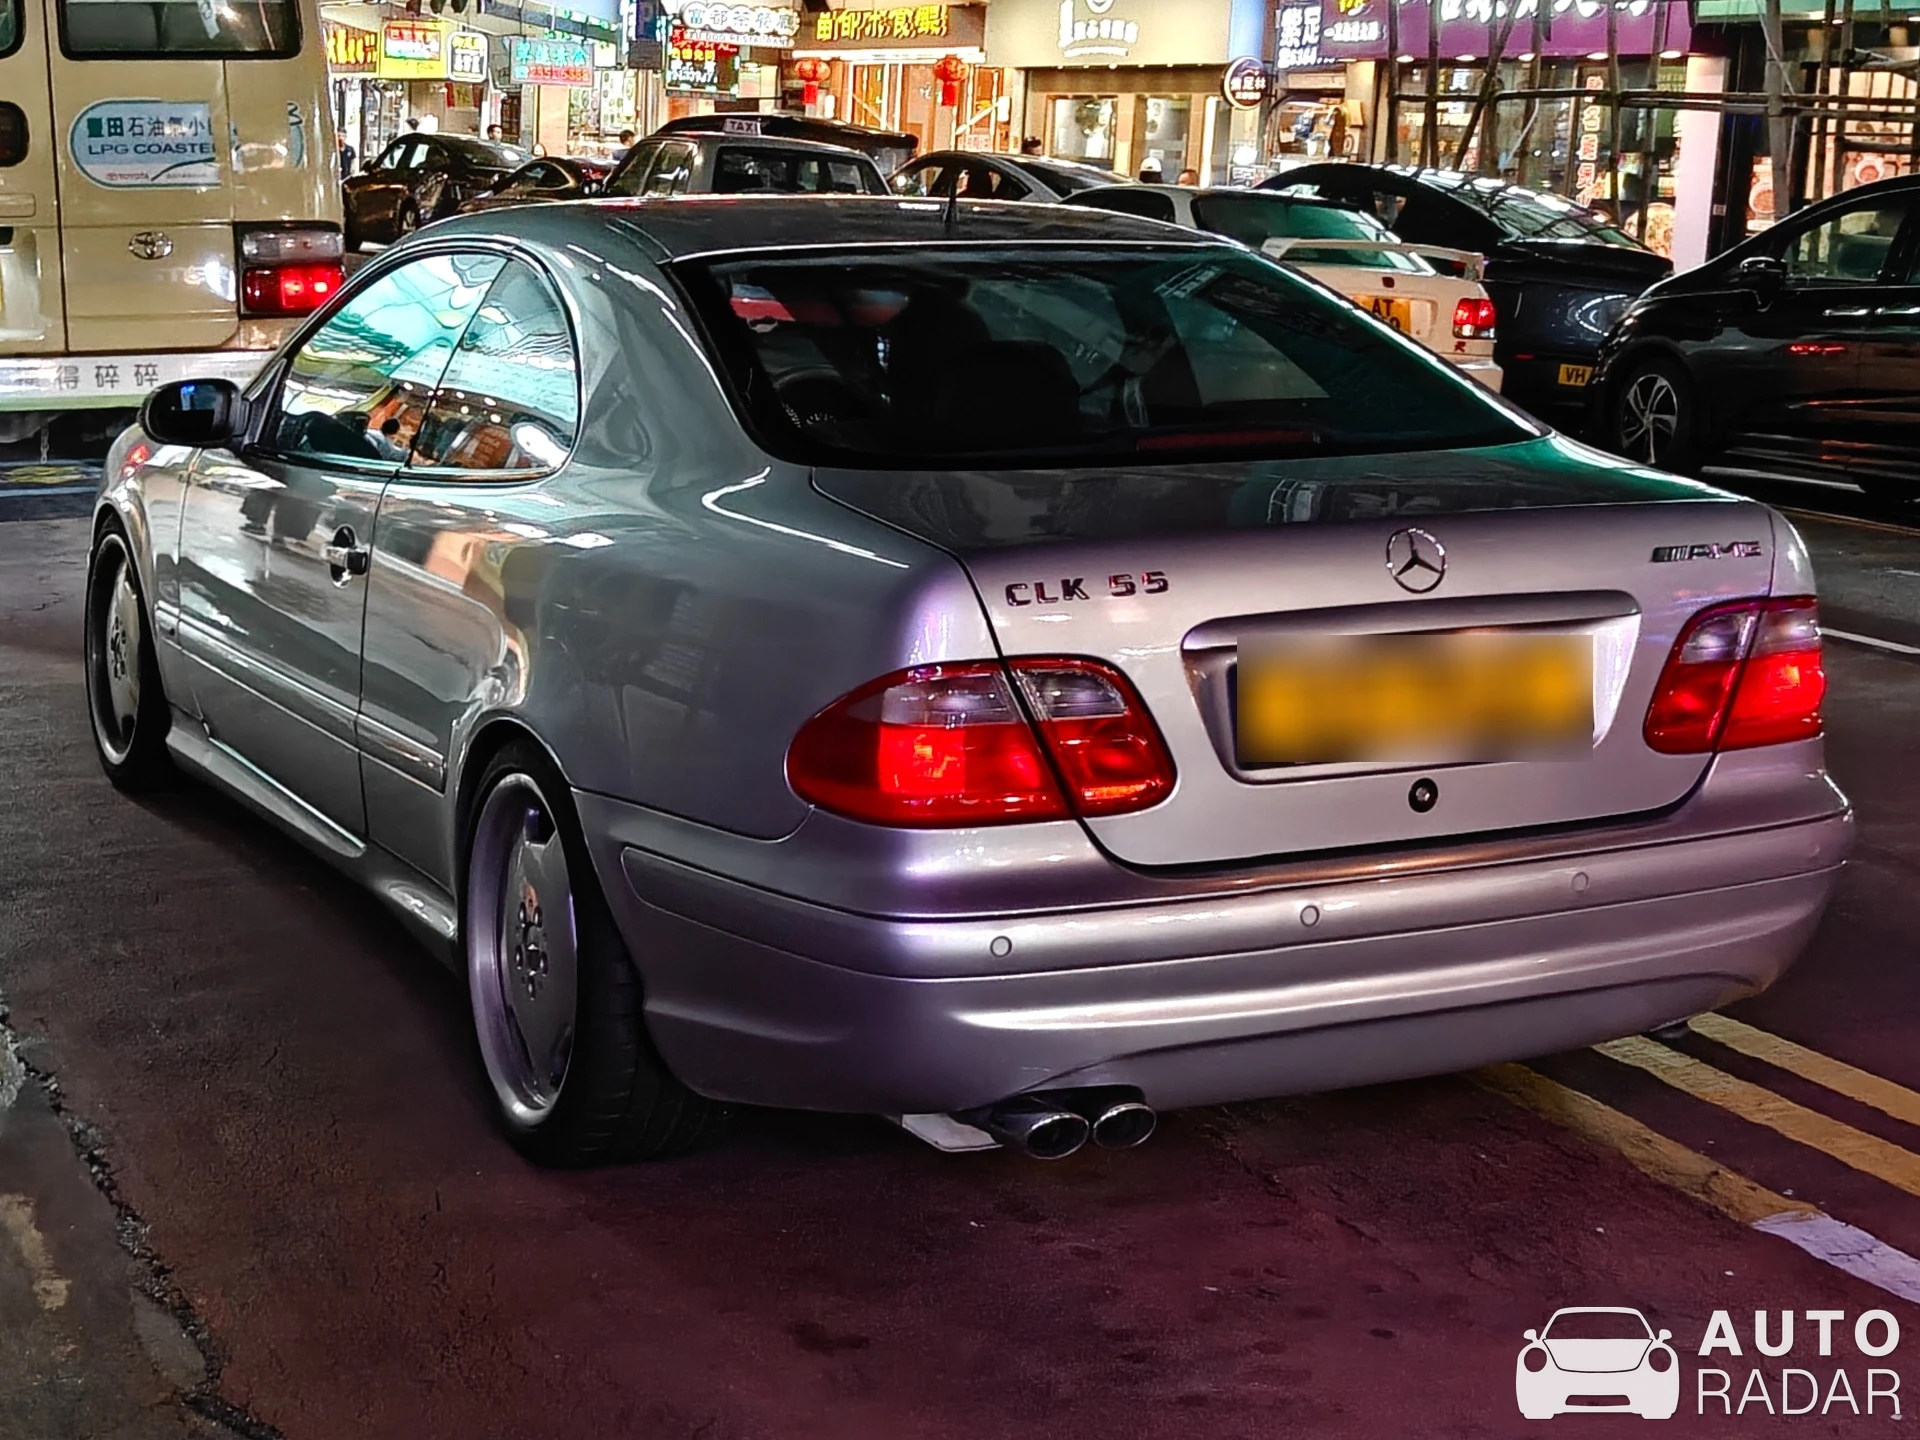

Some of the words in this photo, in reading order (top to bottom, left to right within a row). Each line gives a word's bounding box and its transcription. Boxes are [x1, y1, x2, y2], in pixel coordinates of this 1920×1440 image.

[729, 120, 757, 135] TAXI
[88, 142, 129, 156] LPG
[133, 142, 216, 155] COASTE
[119, 172, 150, 181] TOYOTA
[1371, 298, 1395, 317] AT
[1564, 367, 1586, 384] VH
[1688, 541, 1762, 561] AMG
[1004, 578, 1090, 607] CLK
[1107, 571, 1169, 599] 55
